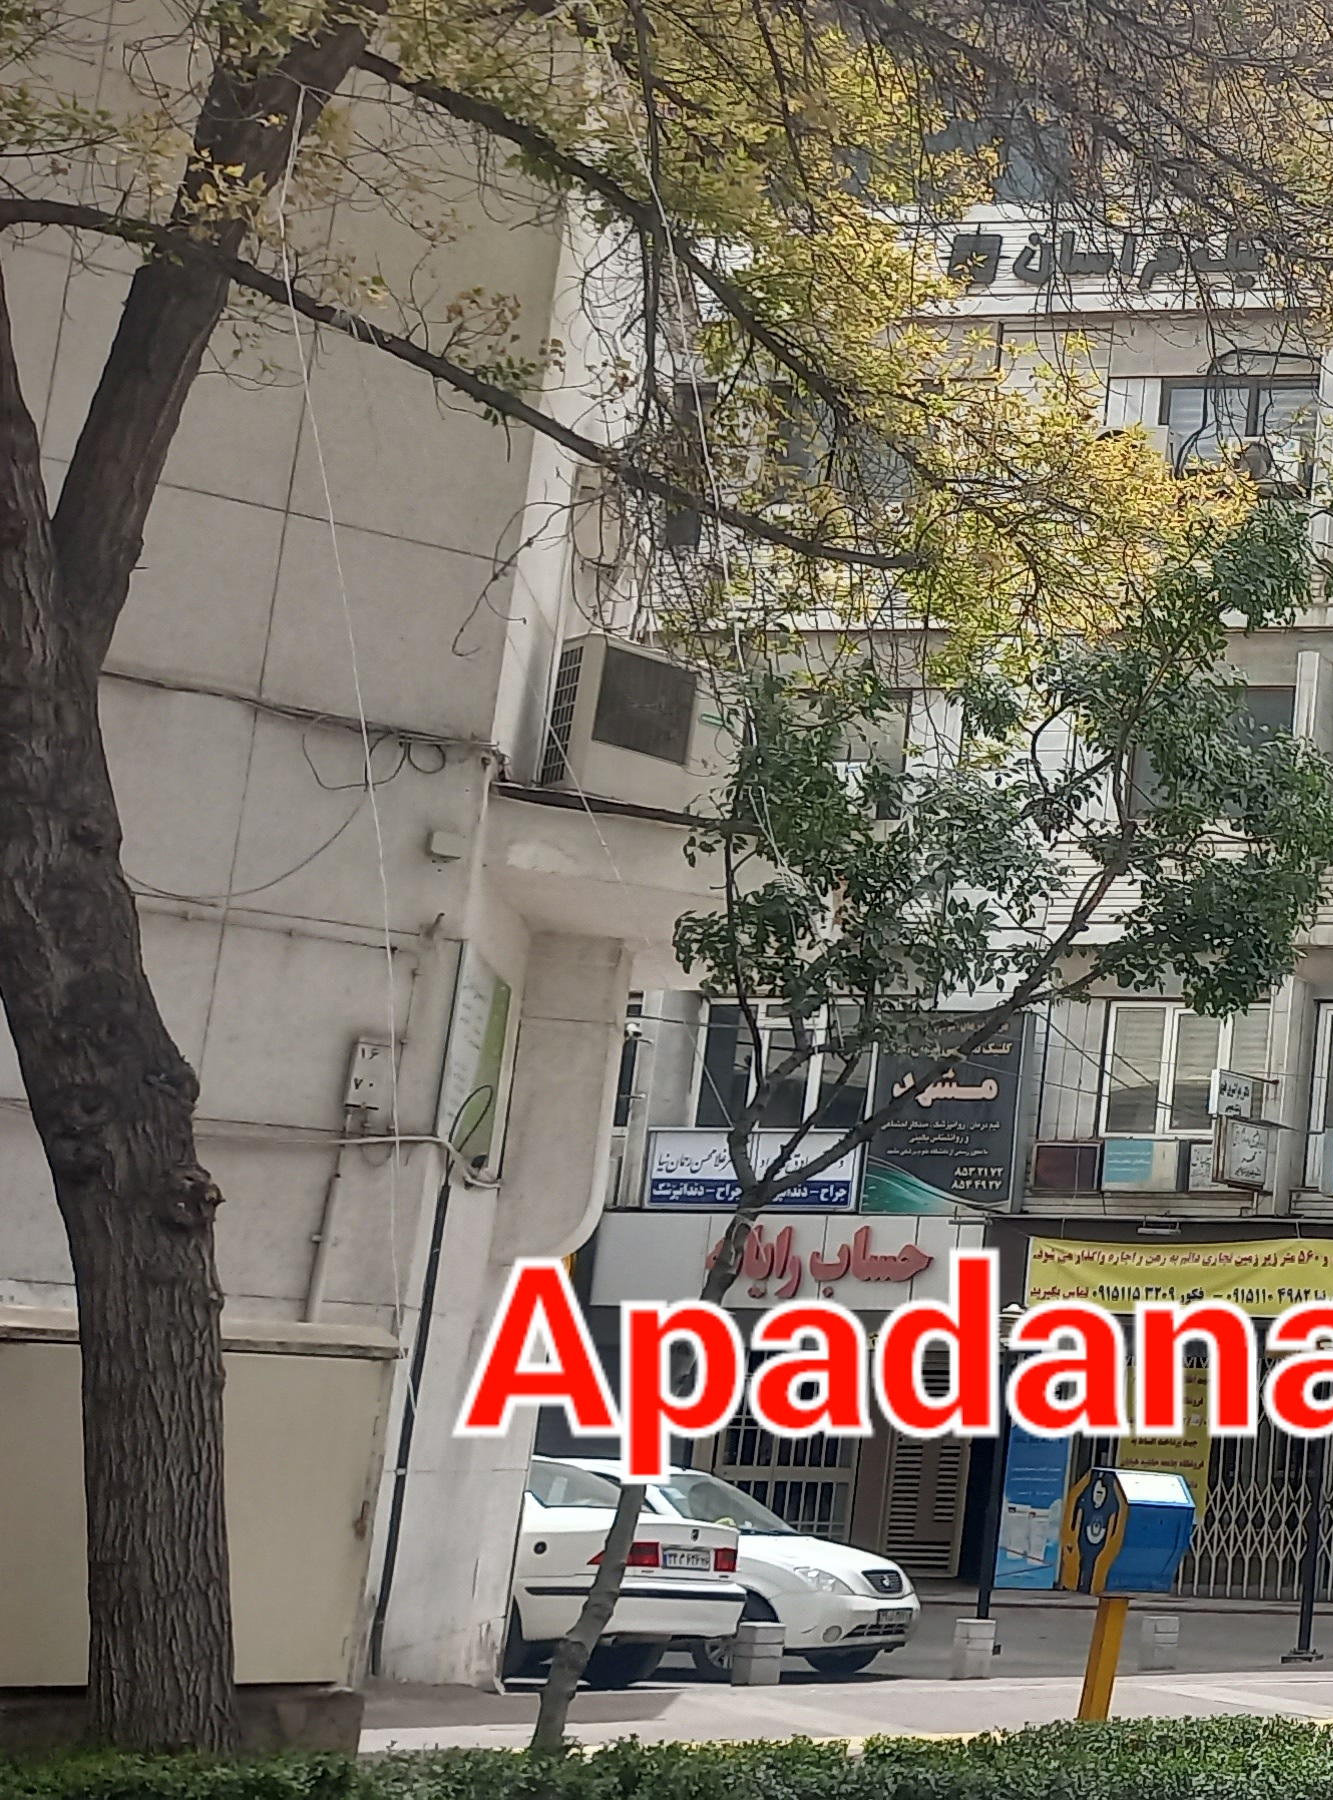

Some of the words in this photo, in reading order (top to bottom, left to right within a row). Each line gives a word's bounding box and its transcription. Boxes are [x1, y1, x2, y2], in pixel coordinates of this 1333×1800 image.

[652, 1182, 705, 1201] دندانپزشک
[715, 1183, 743, 1201] جراح
[820, 1183, 847, 1202] جراح
[808, 1226, 935, 1298] حساب
[1145, 1254, 1167, 1266] رهن
[1169, 1254, 1179, 1266] به
[1280, 1252, 1296, 1267] متر
[1297, 1250, 1319, 1264] ۵۶۰
[1322, 1255, 1328, 1267] و
